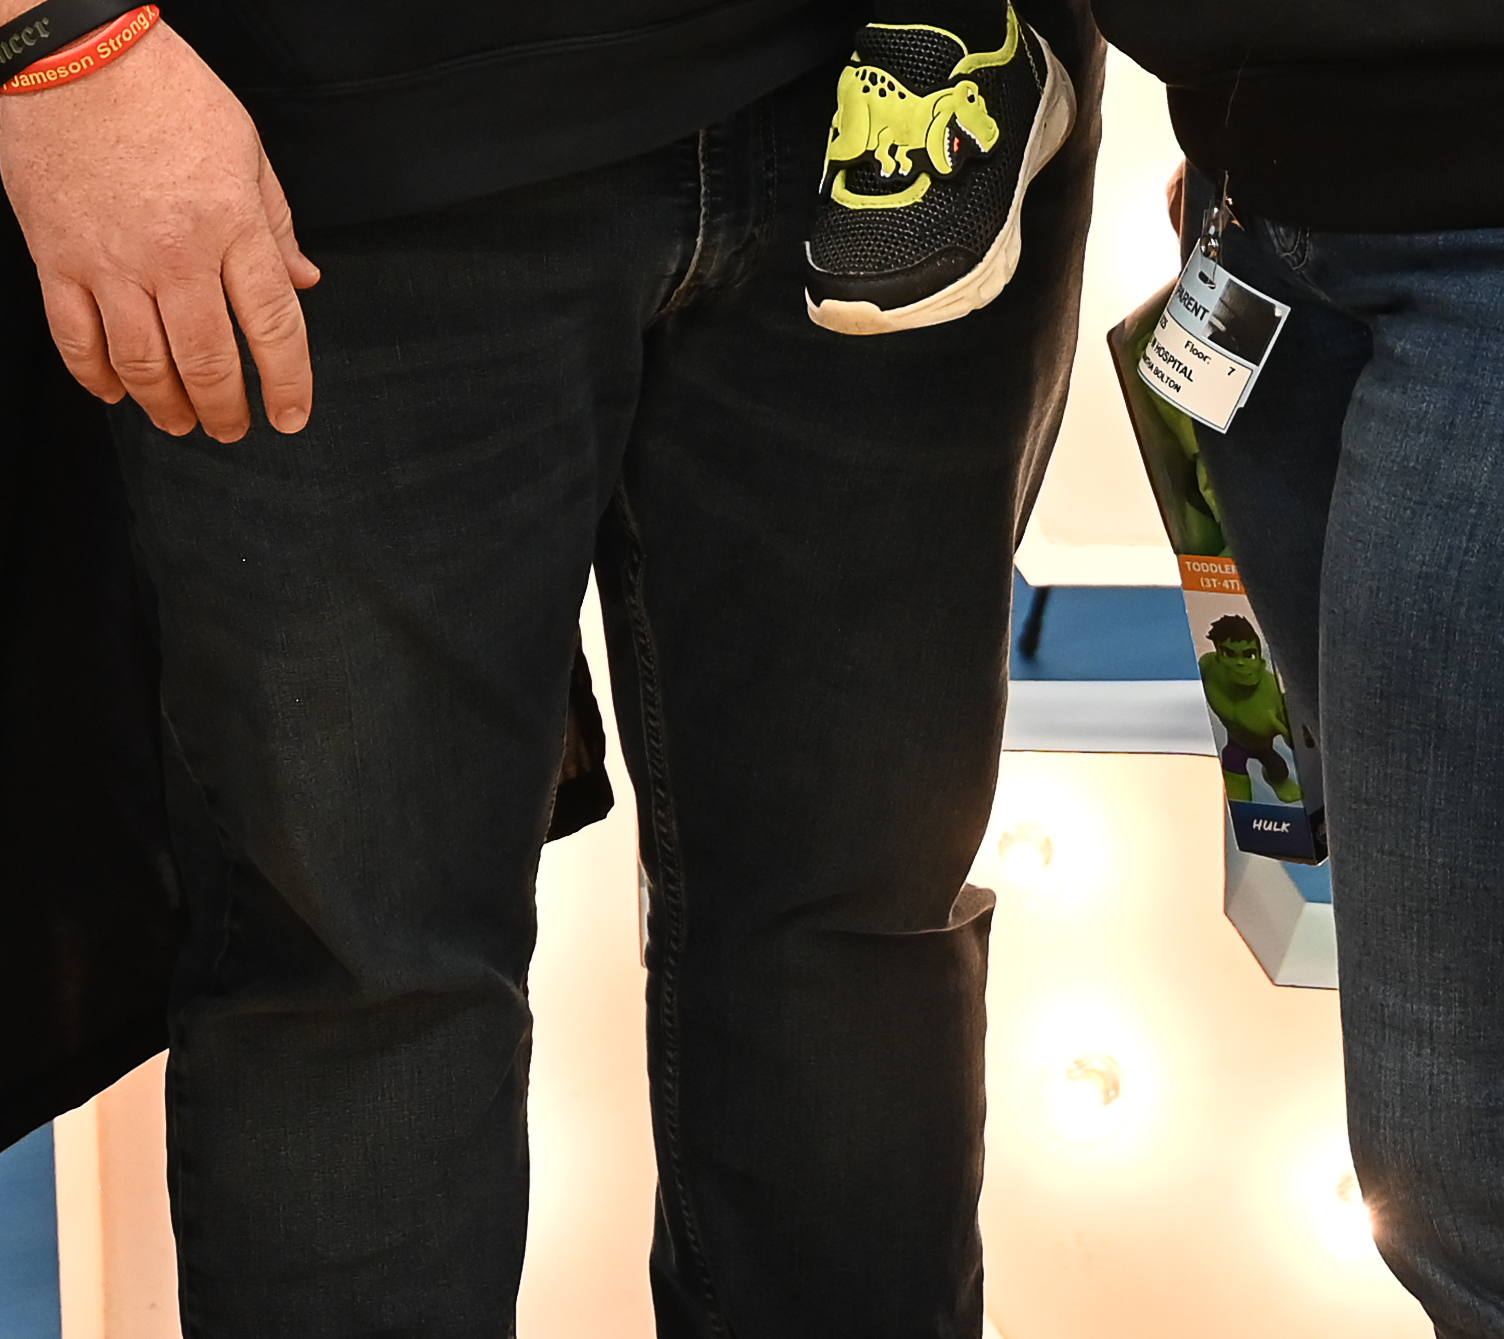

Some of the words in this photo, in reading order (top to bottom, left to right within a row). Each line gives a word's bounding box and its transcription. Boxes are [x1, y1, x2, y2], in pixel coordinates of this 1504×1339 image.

[11, 55, 94, 88] Jameson
[96, 12, 150, 59] Strong
[1154, 343, 1195, 383] HOSPITAL
[1184, 340, 1212, 365] Floor:
[1227, 366, 1237, 377] 7
[1153, 365, 1182, 394] BOLTON
[1252, 819, 1291, 833] HULK
